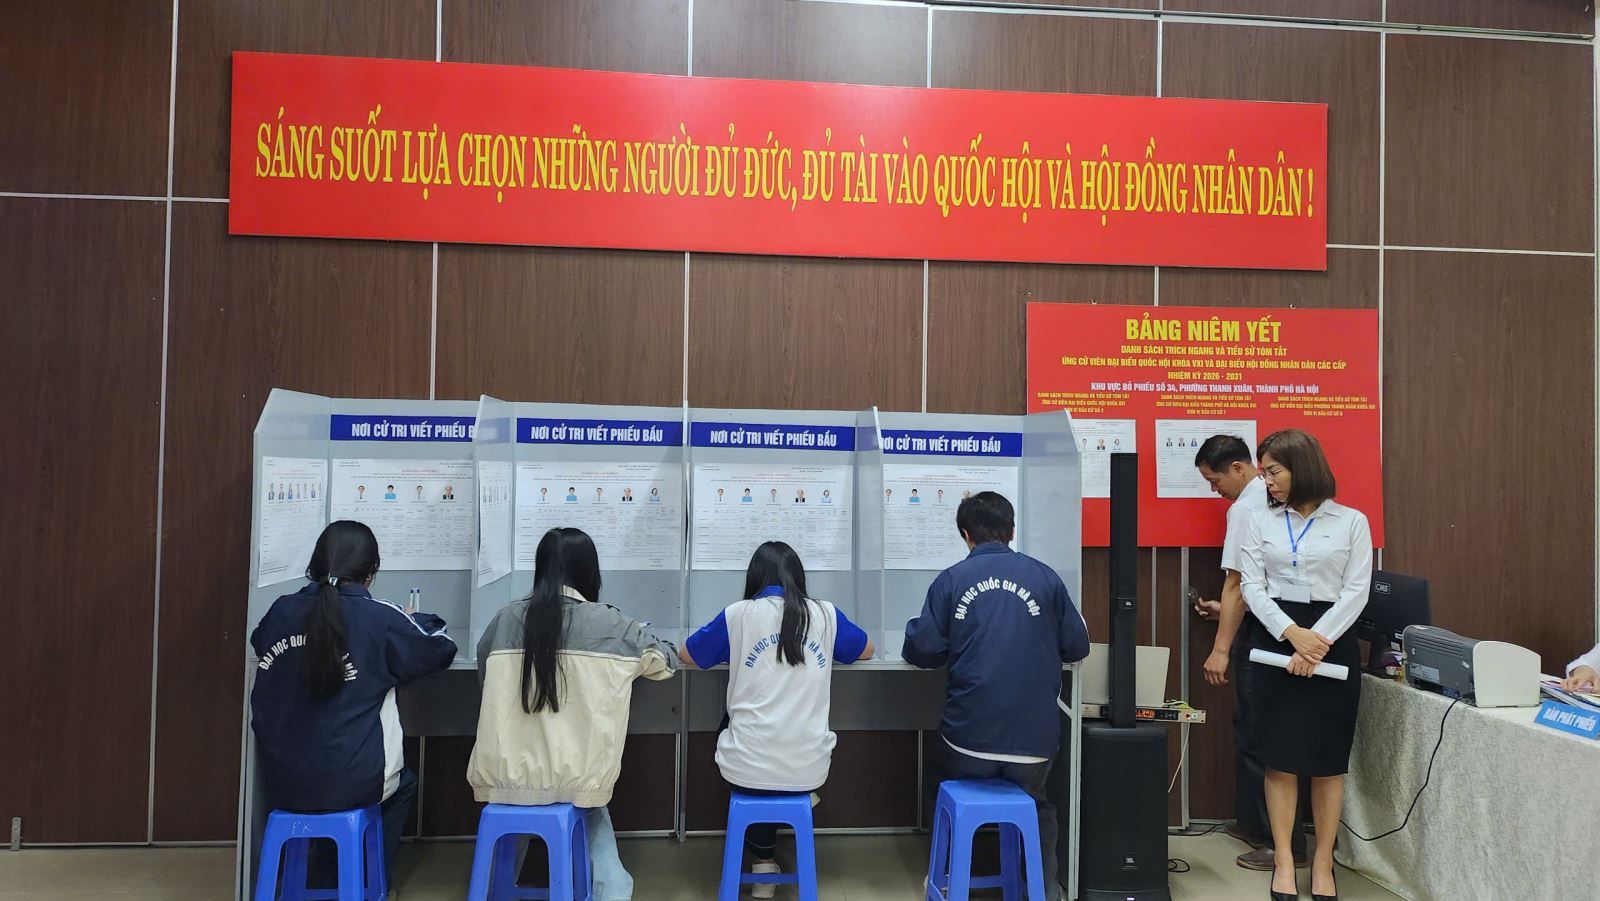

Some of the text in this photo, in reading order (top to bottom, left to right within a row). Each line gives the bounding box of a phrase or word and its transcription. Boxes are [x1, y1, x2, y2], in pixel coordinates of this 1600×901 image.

[255, 106, 324, 180] SÁNG
[330, 104, 397, 182] SUỐT
[402, 123, 451, 201] LỰA
[457, 133, 527, 204] CHỌN
[532, 124, 619, 193] NHỮNG
[623, 122, 700, 196] NGƯỜI
[705, 123, 739, 198] ĐỦ
[743, 130, 798, 212] ĐỨC,
[802, 127, 835, 202] ĐỦ
[841, 135, 878, 203] TÀI
[883, 136, 928, 205] VÀO
[934, 133, 996, 218] QUỐC
[1001, 141, 1042, 224] HỘI
[1046, 143, 1075, 210] VÀ
[1080, 144, 1120, 226] HỘI
[1125, 137, 1187, 213] ĐỒNG
[1192, 148, 1254, 215] NHÂN
[1258, 150, 1303, 217] DÂN
[1126, 312, 1281, 342] BẢNG NIÊM YẾT
[1121, 344, 1287, 356] DANH SÁCH TRÍCH NGANG VÀ TIỂU SỬ TÓM TẮT
[1091, 381, 1319, 395] KHU VỰC BỎ PHIẾU SỐ 34, PHƯỜNG THANH XUÂN, THÀNH PHỐ HÀ NỘI
[352, 423, 370, 437] NƠI
[373, 420, 390, 437] CỬ
[391, 424, 407, 437] TRI
[410, 421, 432, 438] VIẾT
[434, 421, 466, 438] PHIẾU
[531, 426, 549, 440] NƠI
[552, 423, 567, 440] CỬ
[568, 427, 584, 441] TRI
[587, 424, 608, 441] VIẾT
[611, 424, 640, 442] PHIẾU
[710, 430, 728, 443] NƠI
[730, 427, 745, 444] CỬ
[746, 431, 761, 444] TRI
[764, 429, 784, 445] VIẾT
[786, 429, 814, 446] PHIẾU
[896, 434, 910, 450] CỬ
[912, 438, 926, 450] TRI
[929, 435, 950, 452] VIẾT
[951, 436, 979, 452] PHIẾU
[1376, 584, 1389, 592] CMS
[955, 604, 967, 620] ĐẠI
[961, 586, 978, 605] HỌC
[977, 576, 1000, 592] QUỐC
[1002, 580, 1017, 593] GIA
[258, 652, 274, 671] ĐẠI
[271, 638, 288, 656] HỌC
[754, 638, 769, 654] HỌC
